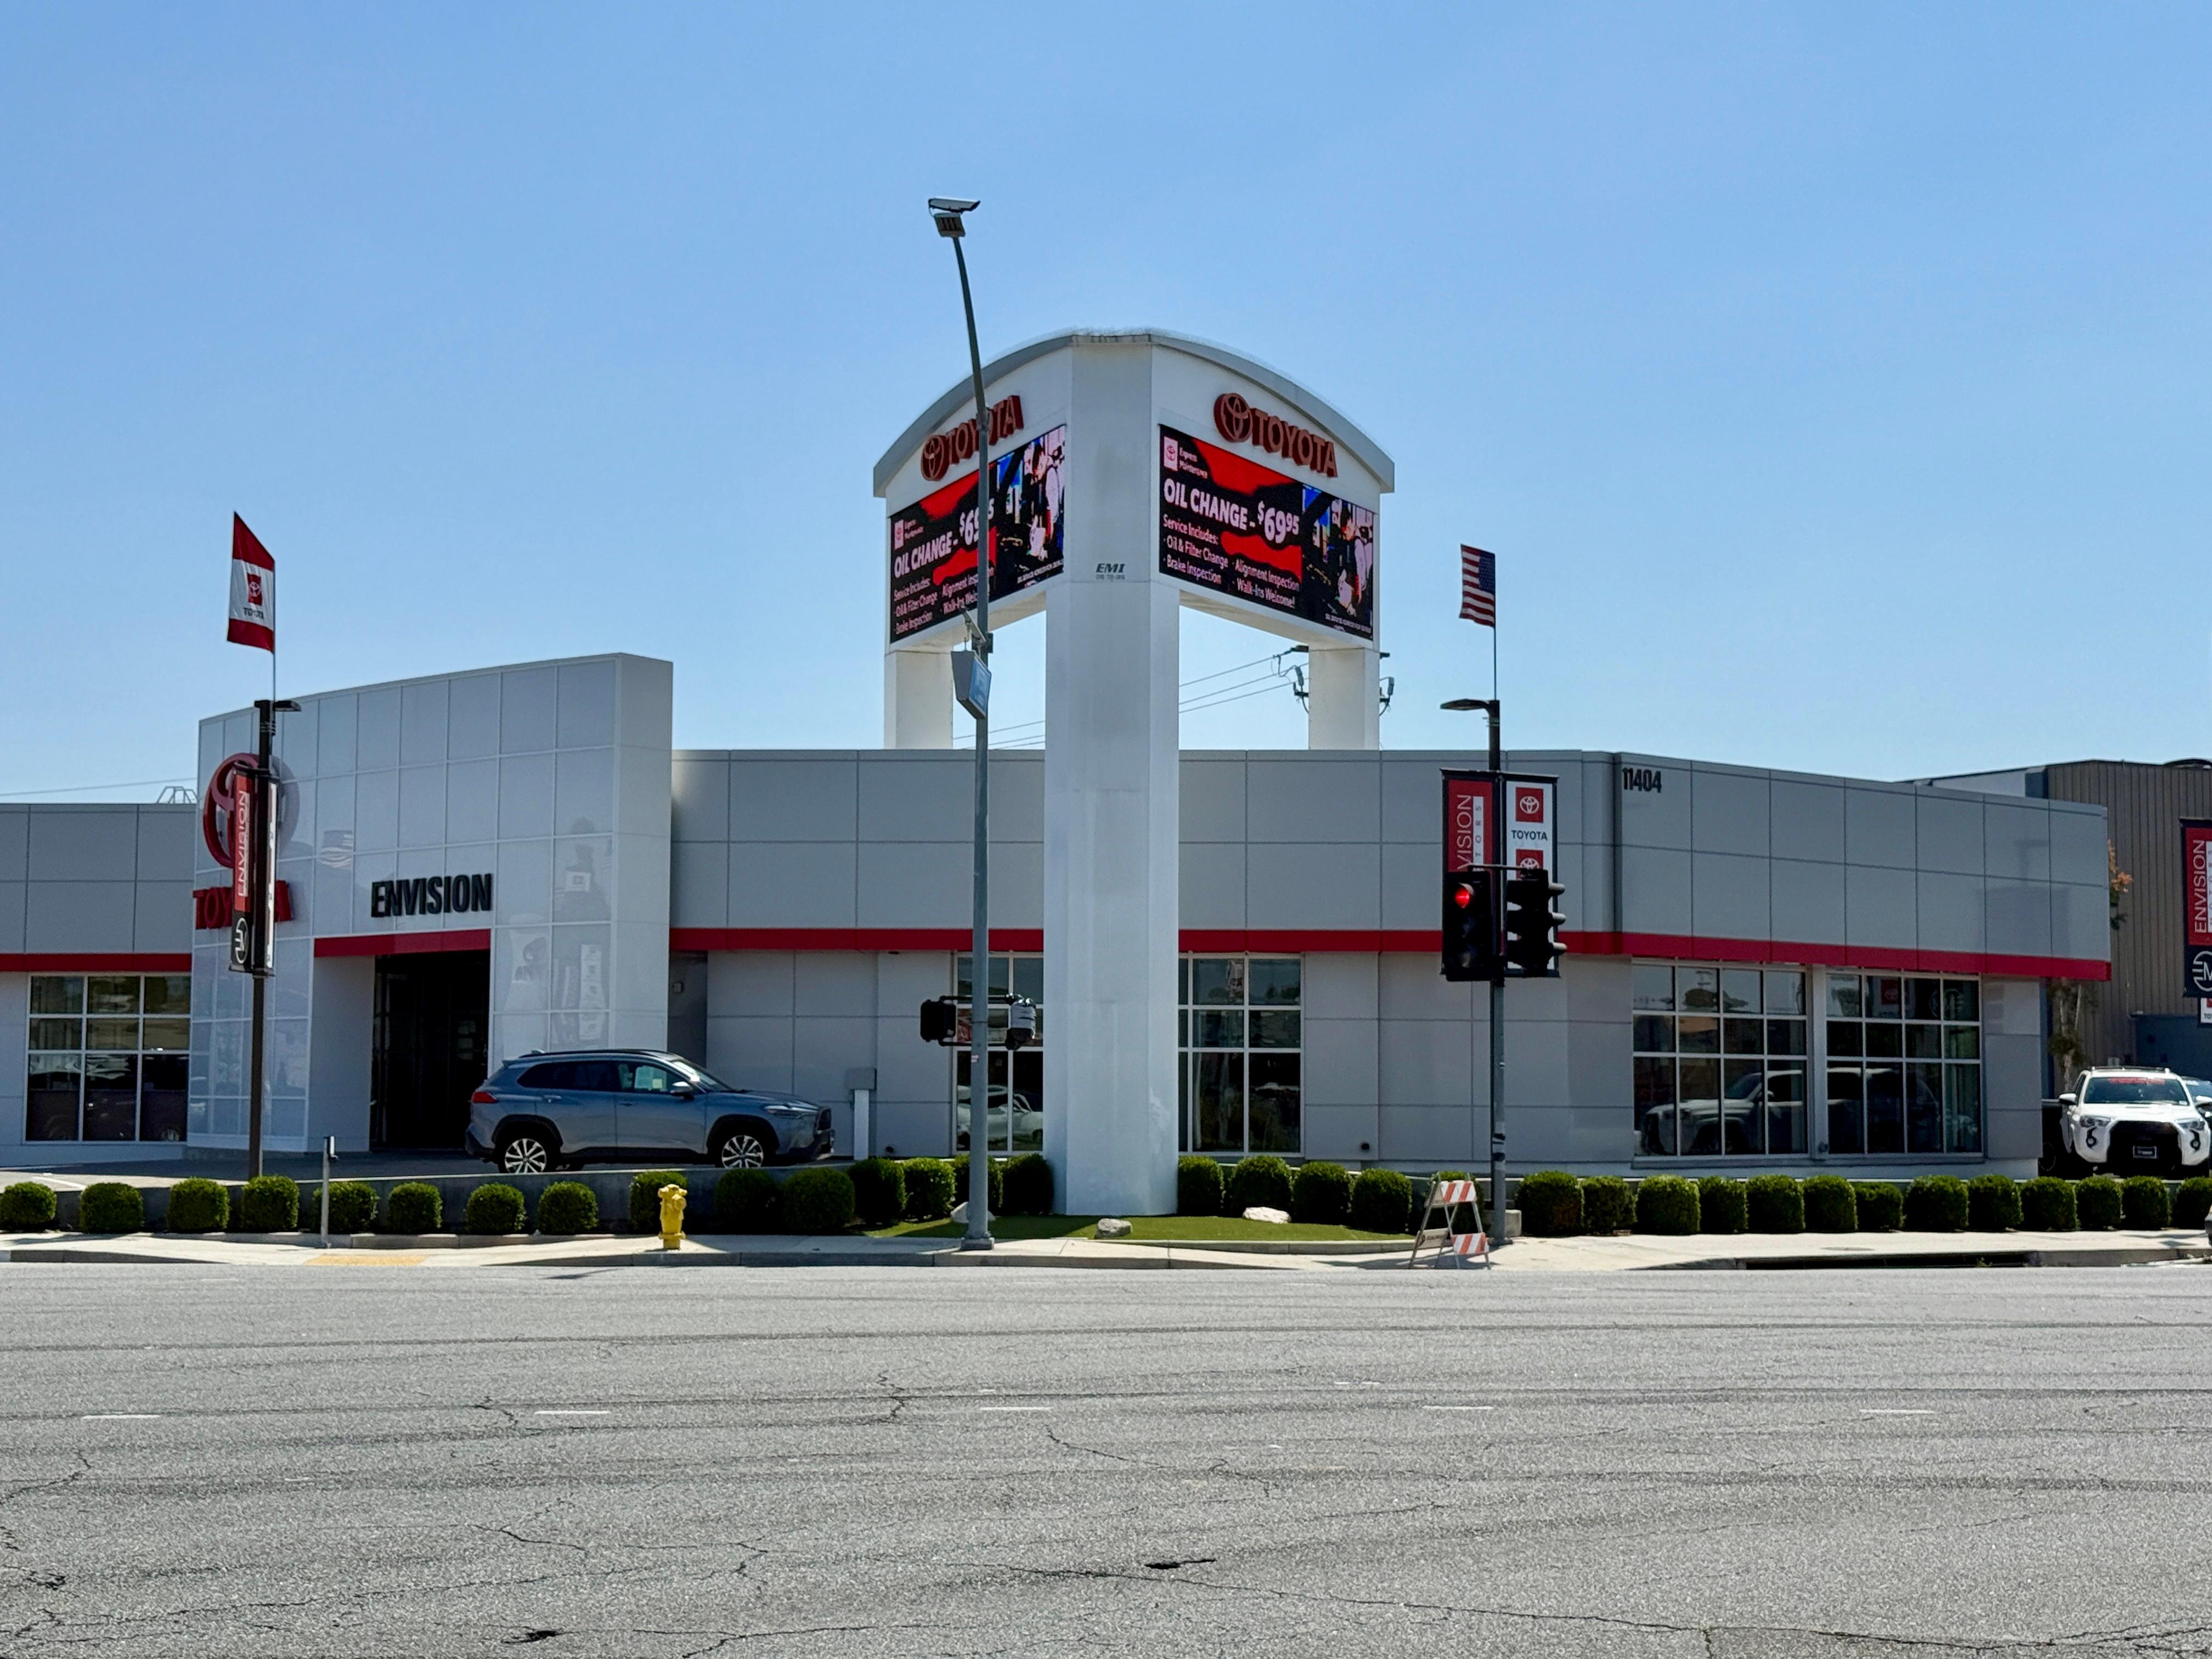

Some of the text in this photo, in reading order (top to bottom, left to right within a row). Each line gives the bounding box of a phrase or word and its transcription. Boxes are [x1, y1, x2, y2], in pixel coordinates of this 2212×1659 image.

[1250, 408, 1338, 478] TOYOTA
[1164, 478, 1187, 509] OIL
[1190, 488, 1248, 531] CHANGE
[1164, 514, 1187, 535] Service
[894, 552, 910, 578] OIL
[911, 531, 952, 570] CHANGE
[1096, 563, 1125, 573] EMI
[1167, 535, 1177, 550] Oil
[1185, 541, 1202, 558] Filter
[1203, 548, 1228, 569] Change
[1167, 554, 1222, 584] Brake Inspection
[1235, 558, 1299, 591] Alignment Inspection
[1622, 768, 1662, 793] 11404
[1511, 830, 1548, 841] TOYOTA
[371, 873, 492, 917] ENVISION
[2193, 840, 2207, 933] ENVISION
